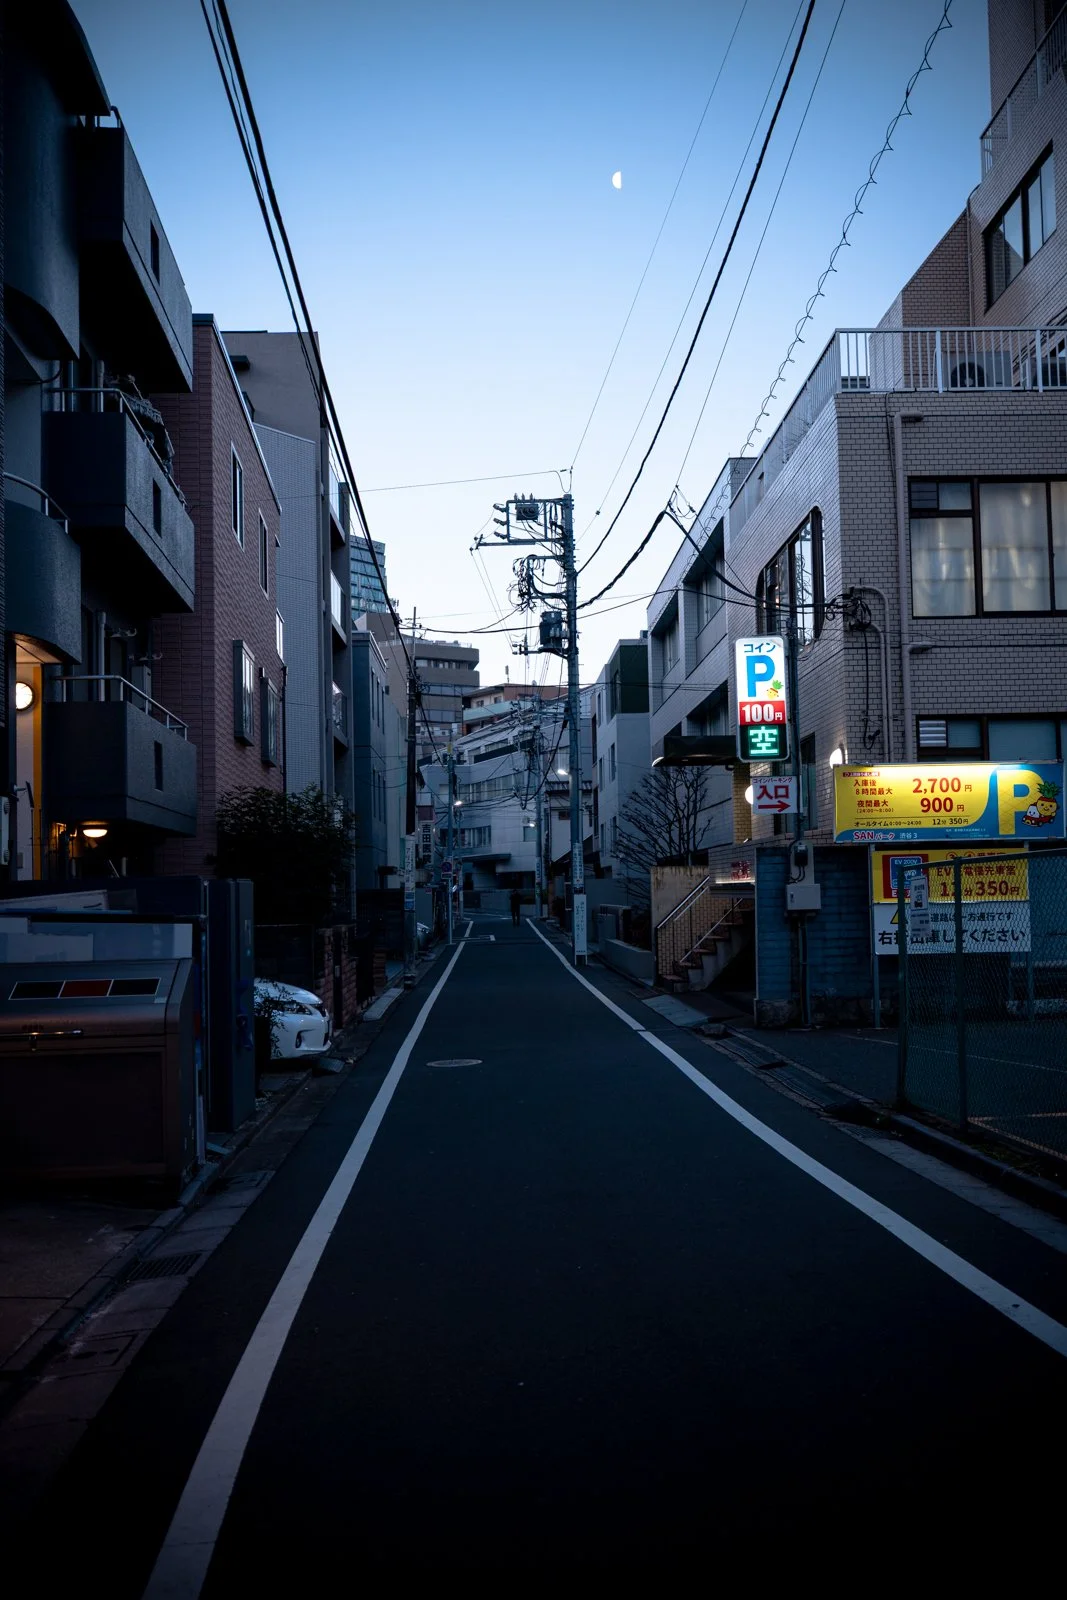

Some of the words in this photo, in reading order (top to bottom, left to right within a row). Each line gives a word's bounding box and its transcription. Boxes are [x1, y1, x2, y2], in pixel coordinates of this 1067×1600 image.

[744, 643, 776, 653] コイン
[746, 655, 775, 697] P
[742, 704, 783, 722] 100円
[749, 726, 778, 755] 空
[757, 785, 789, 800] 入口
[855, 787, 893, 795] 8時間最大
[857, 799, 889, 807] 夜間最大
[997, 770, 1044, 835] P
